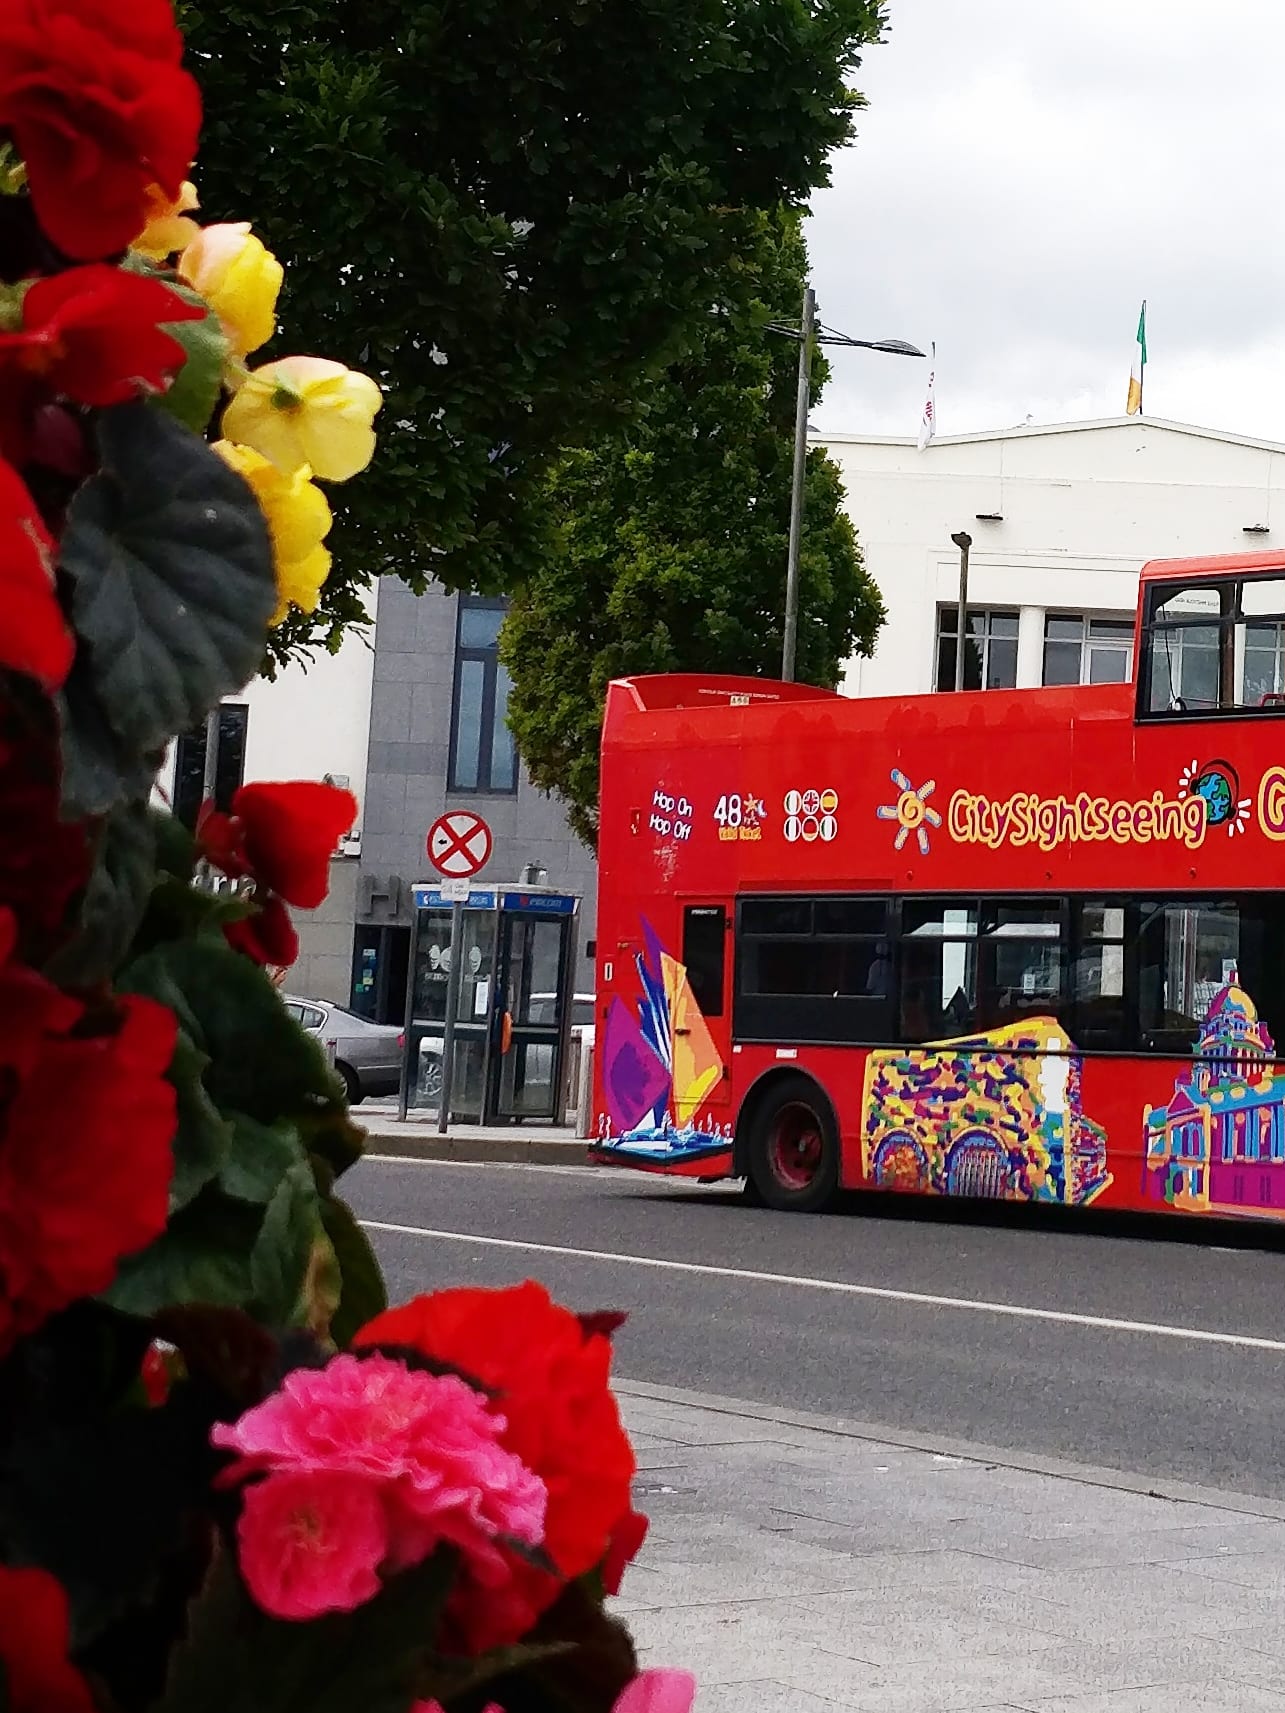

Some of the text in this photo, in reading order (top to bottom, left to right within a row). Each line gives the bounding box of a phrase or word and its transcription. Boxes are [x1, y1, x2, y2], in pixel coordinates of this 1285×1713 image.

[653, 790, 693, 817] Hop On
[713, 794, 742, 827] 48
[649, 814, 692, 840] Hop Off
[948, 788, 1207, 851] CitySightseeing
